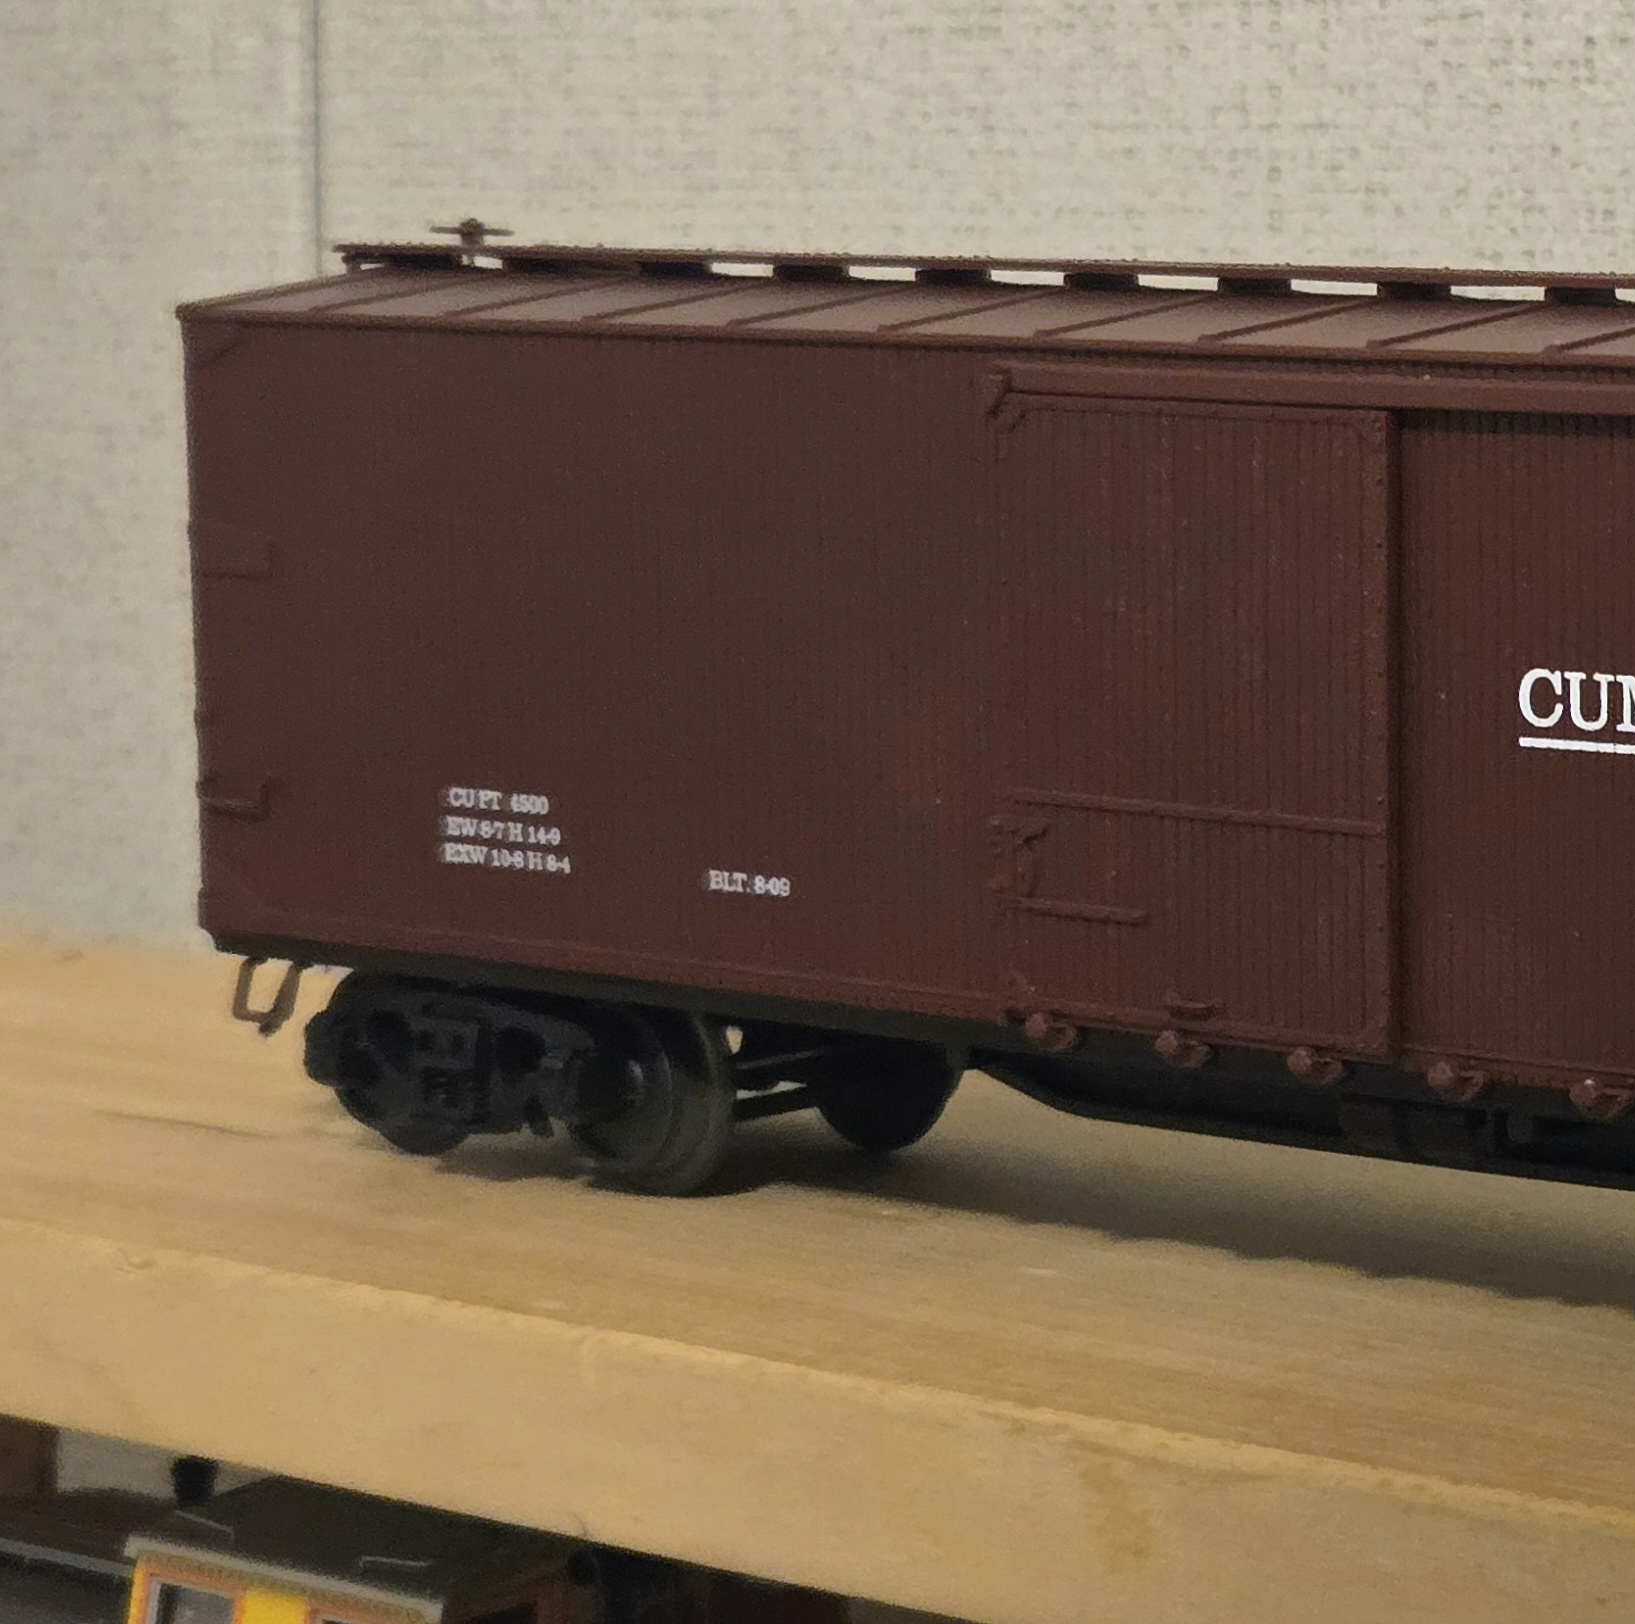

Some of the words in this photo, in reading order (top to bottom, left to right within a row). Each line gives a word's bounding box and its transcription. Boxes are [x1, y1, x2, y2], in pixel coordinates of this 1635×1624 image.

[448, 787, 475, 808] CU
[446, 815, 478, 836] EW
[507, 822, 523, 842] H
[526, 850, 543, 870] H
[708, 869, 751, 893] BLT.
[754, 874, 791, 897] 8-09
